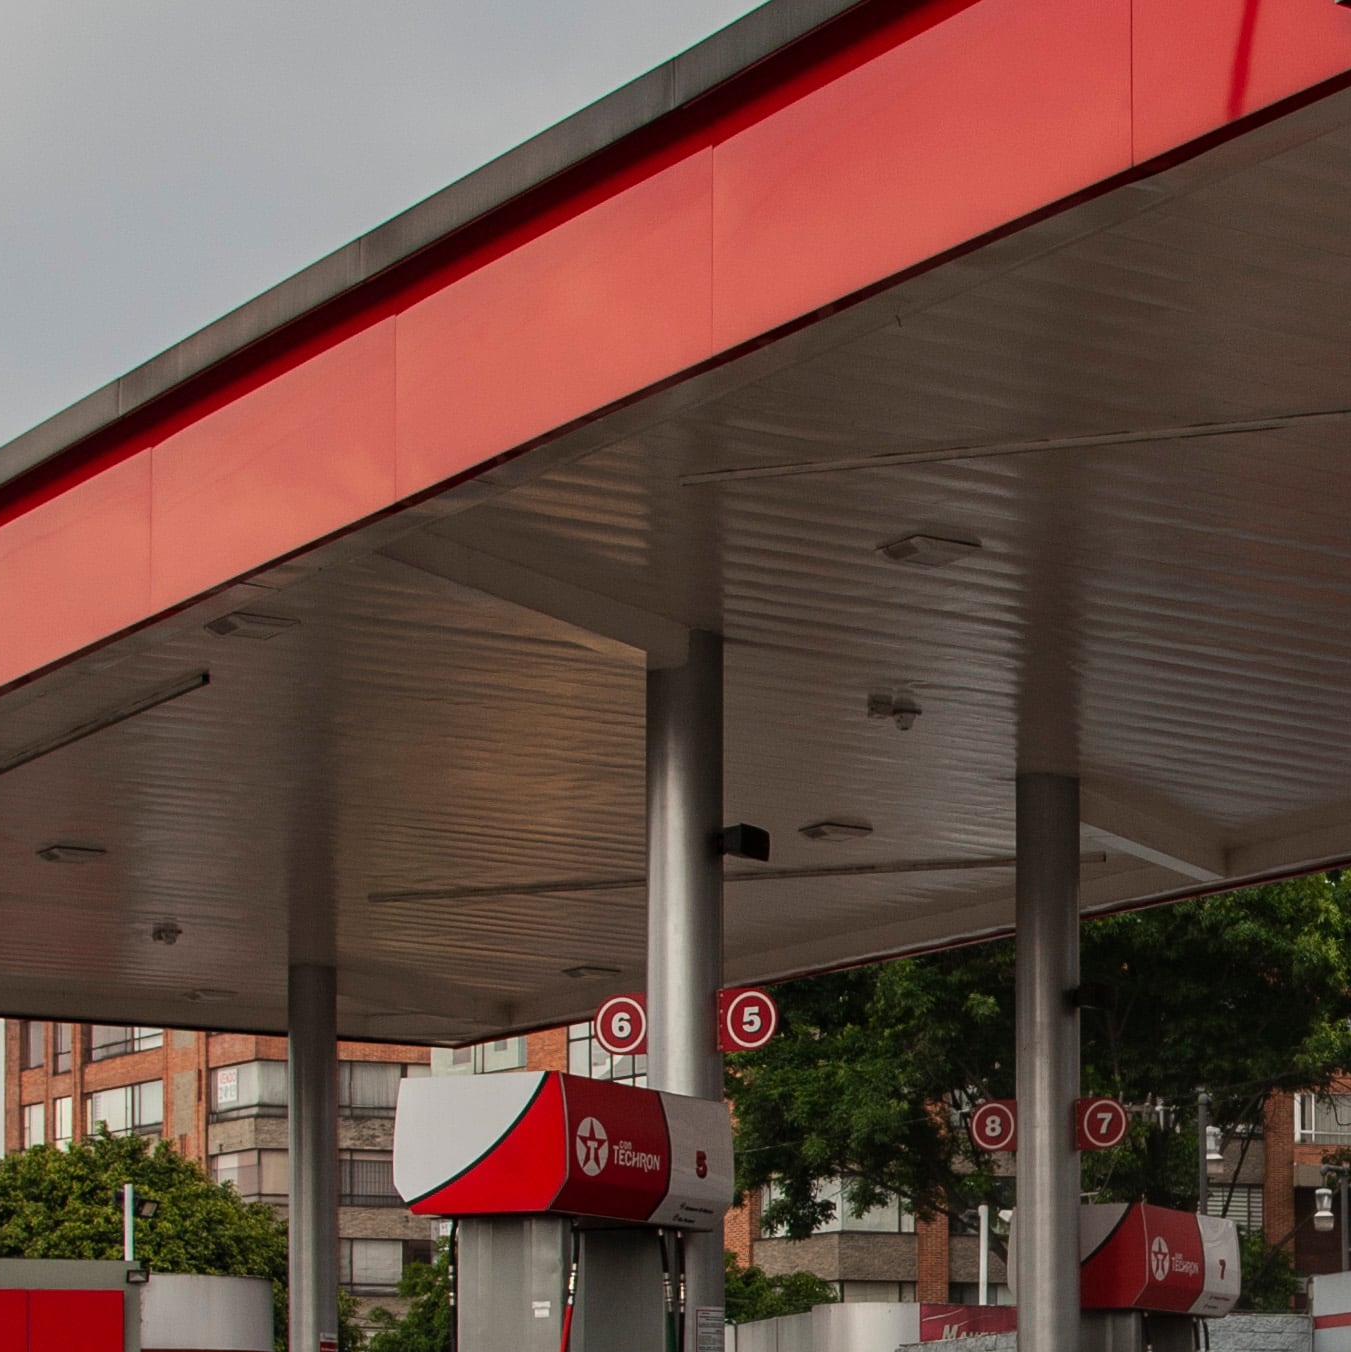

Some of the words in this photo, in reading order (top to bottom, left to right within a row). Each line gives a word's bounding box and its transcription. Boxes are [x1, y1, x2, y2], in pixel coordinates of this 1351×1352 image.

[611, 1011, 632, 1038] 6
[742, 1006, 762, 1033] 5
[985, 1115, 1002, 1137] 8
[1097, 1112, 1113, 1135] 7
[613, 1145, 661, 1172] TECHRON
[696, 1150, 708, 1179] 5
